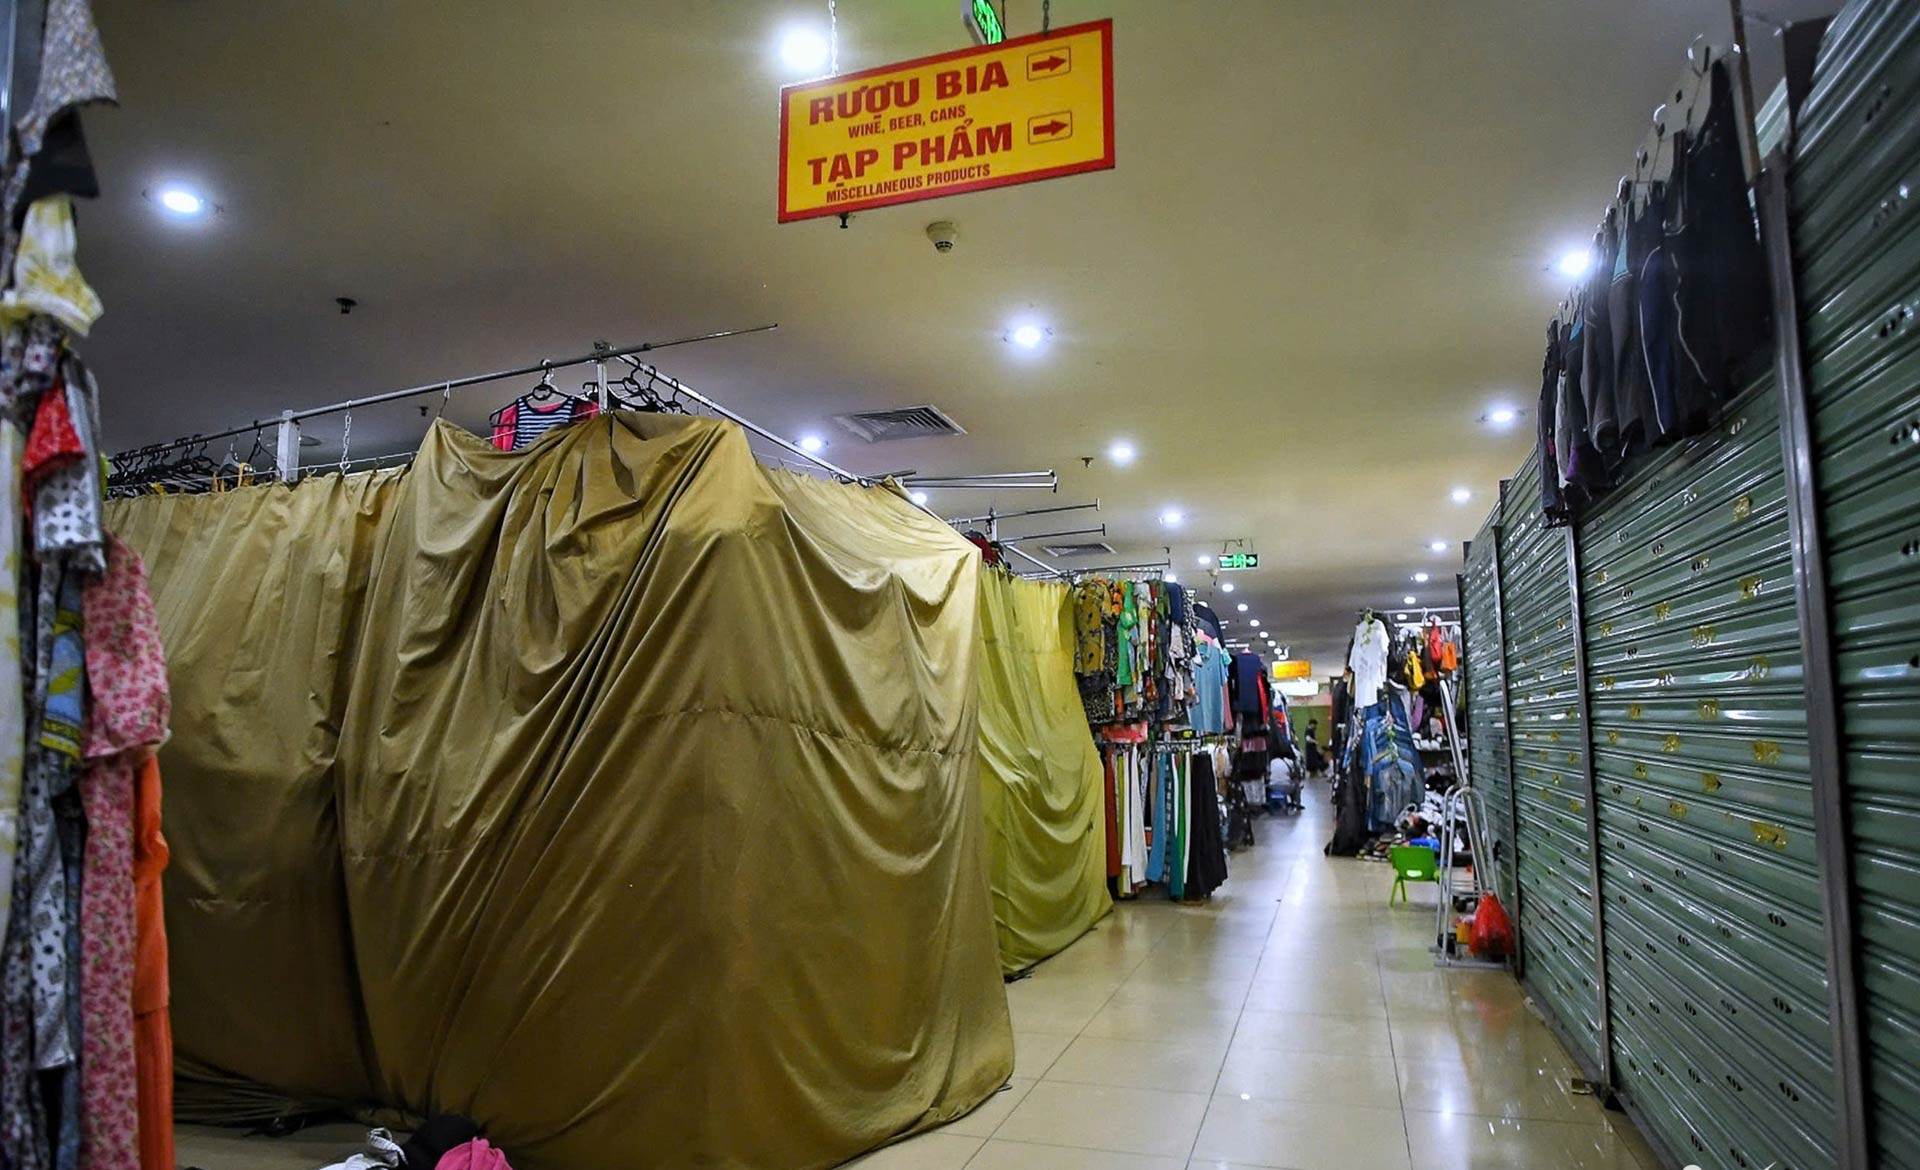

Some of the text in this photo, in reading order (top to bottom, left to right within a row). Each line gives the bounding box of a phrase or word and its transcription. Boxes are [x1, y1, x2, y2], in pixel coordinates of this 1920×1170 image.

[809, 61, 1009, 125] RƯỢU BIA
[848, 105, 966, 138] WINE, BEER, CANS
[807, 118, 1012, 187] TẠP PHẨM
[826, 164, 990, 203] MISCELLANEOUS PRODUCTS
